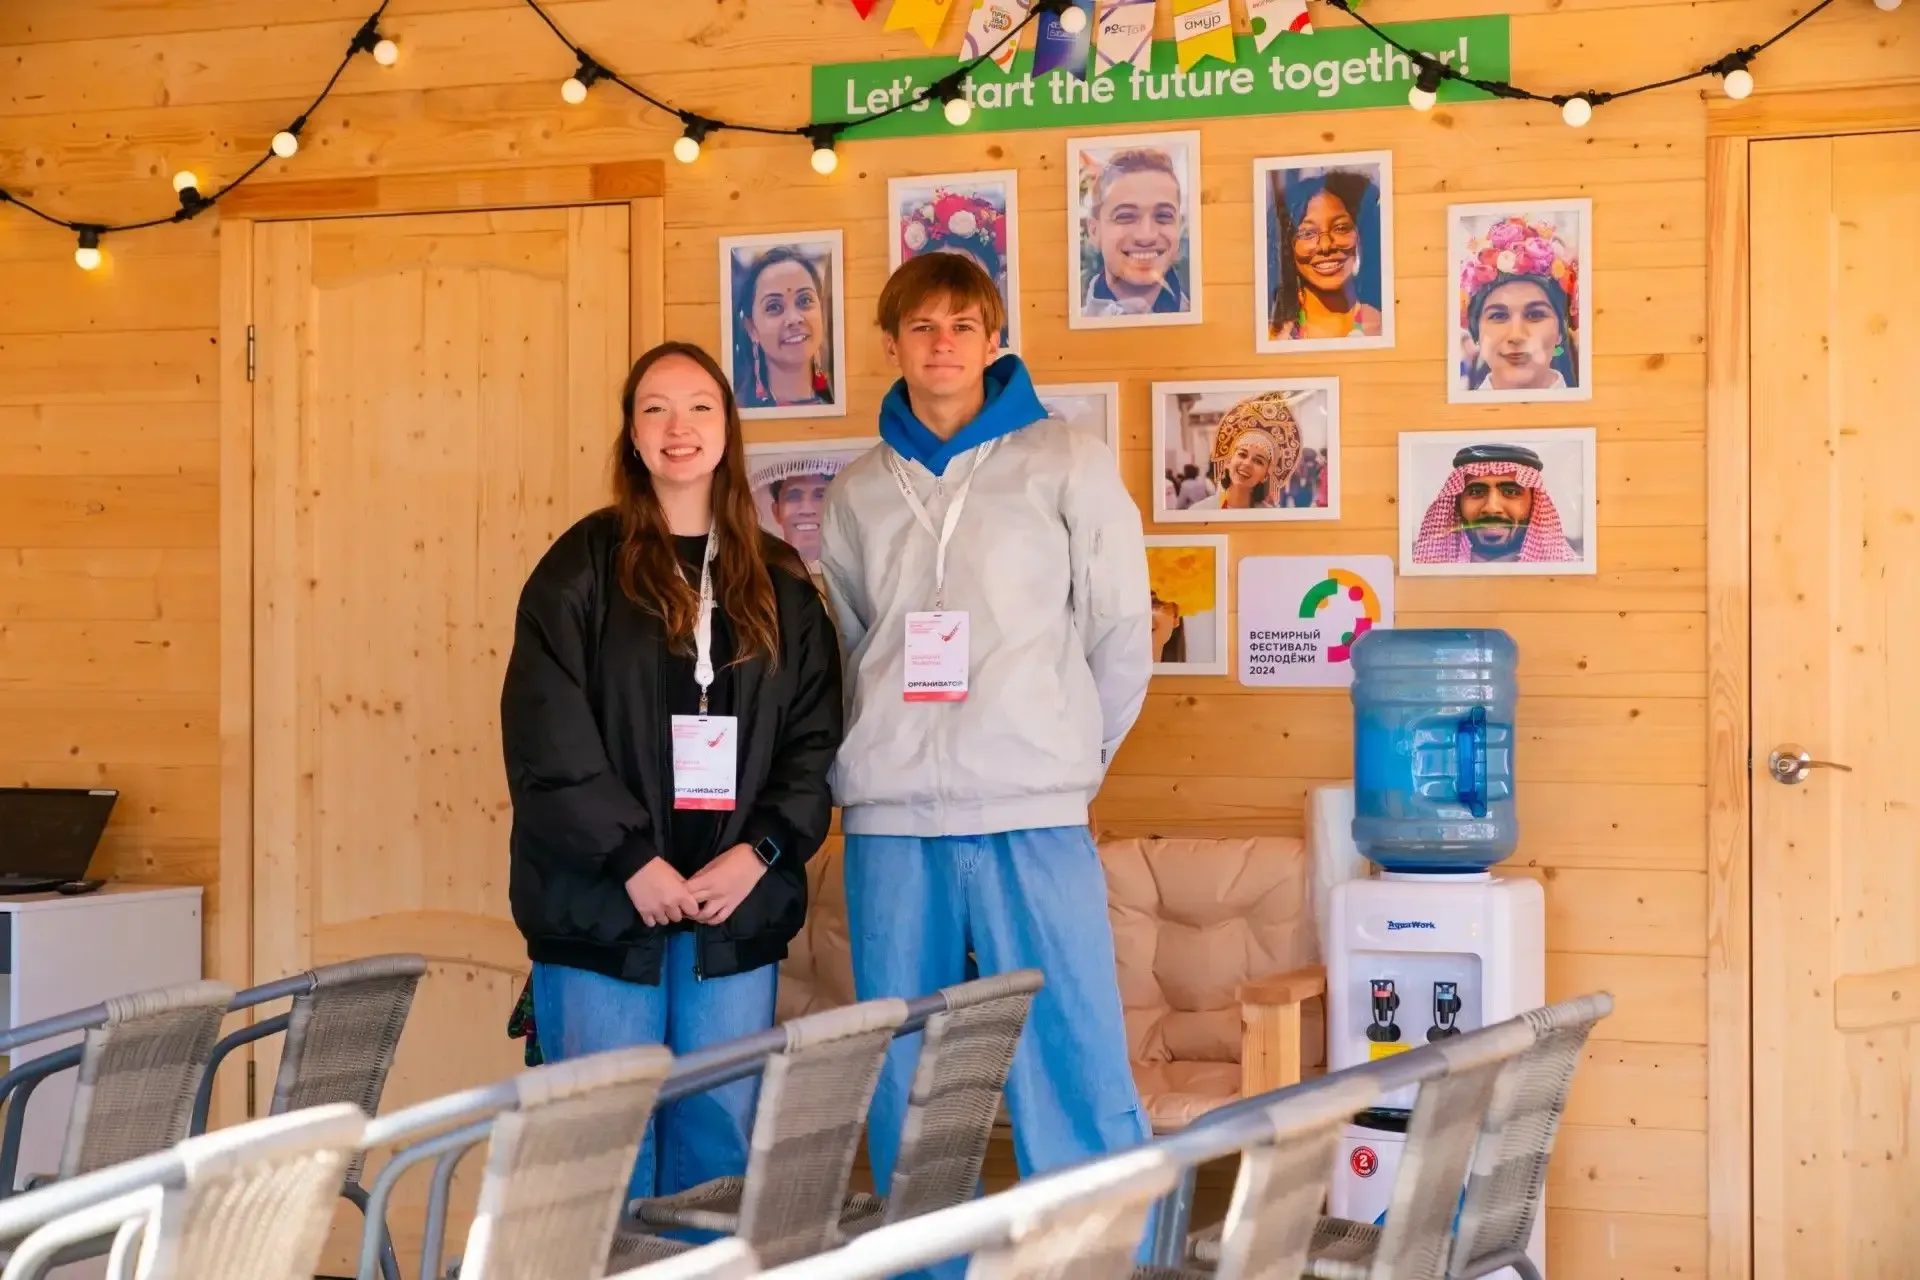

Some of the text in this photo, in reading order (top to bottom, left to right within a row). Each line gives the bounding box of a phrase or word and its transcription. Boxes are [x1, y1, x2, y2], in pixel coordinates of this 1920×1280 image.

[846, 75, 930, 114] Let's
[944, 72, 1036, 110] tart
[1048, 71, 1115, 104] the
[1128, 64, 1254, 101] future
[1249, 629, 1321, 640] ВСЕМИРНЫЙ
[1249, 642, 1318, 652] ФЕСТИВАЛЬ
[1249, 652, 1316, 664] МОЛОДЁЖИ
[1249, 666, 1276, 675] 2024
[907, 680, 964, 688] ОРГАНИЗАТОР
[1359, 1154, 1369, 1167] 2
